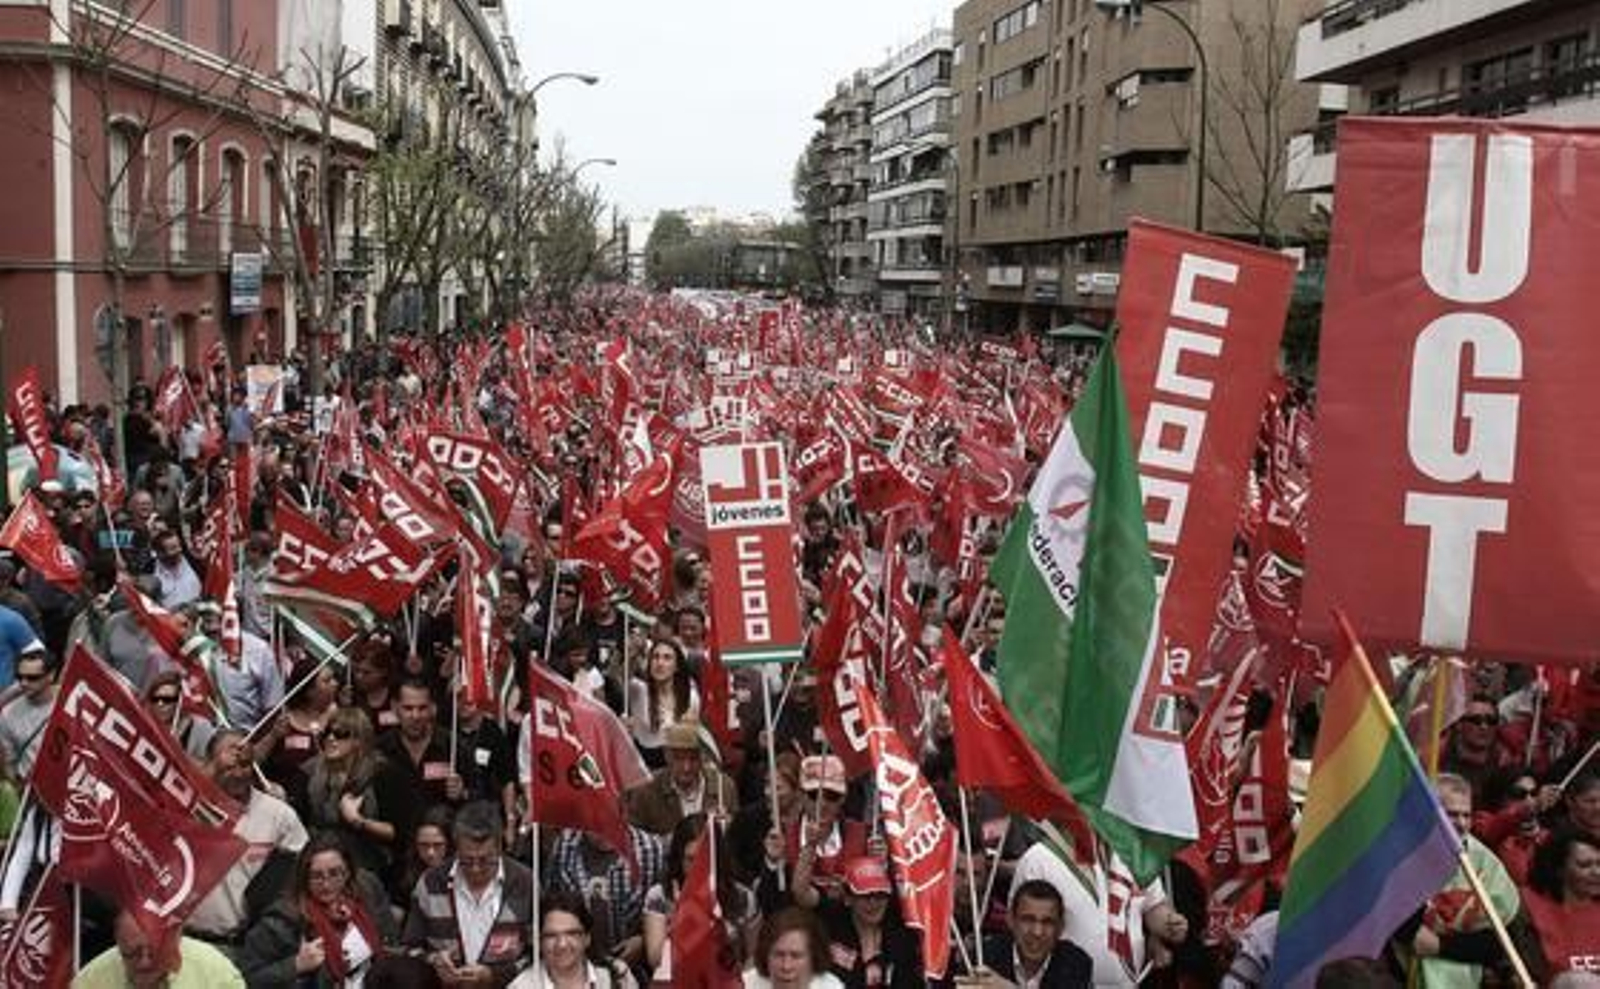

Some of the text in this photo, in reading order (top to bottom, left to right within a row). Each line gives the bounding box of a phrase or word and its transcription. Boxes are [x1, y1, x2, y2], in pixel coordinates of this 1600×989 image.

[1138, 252, 1240, 545] CCOO
[1404, 133, 1533, 650] UGT
[711, 503, 785, 525] jóvenes
[736, 535, 771, 641] CCOO
